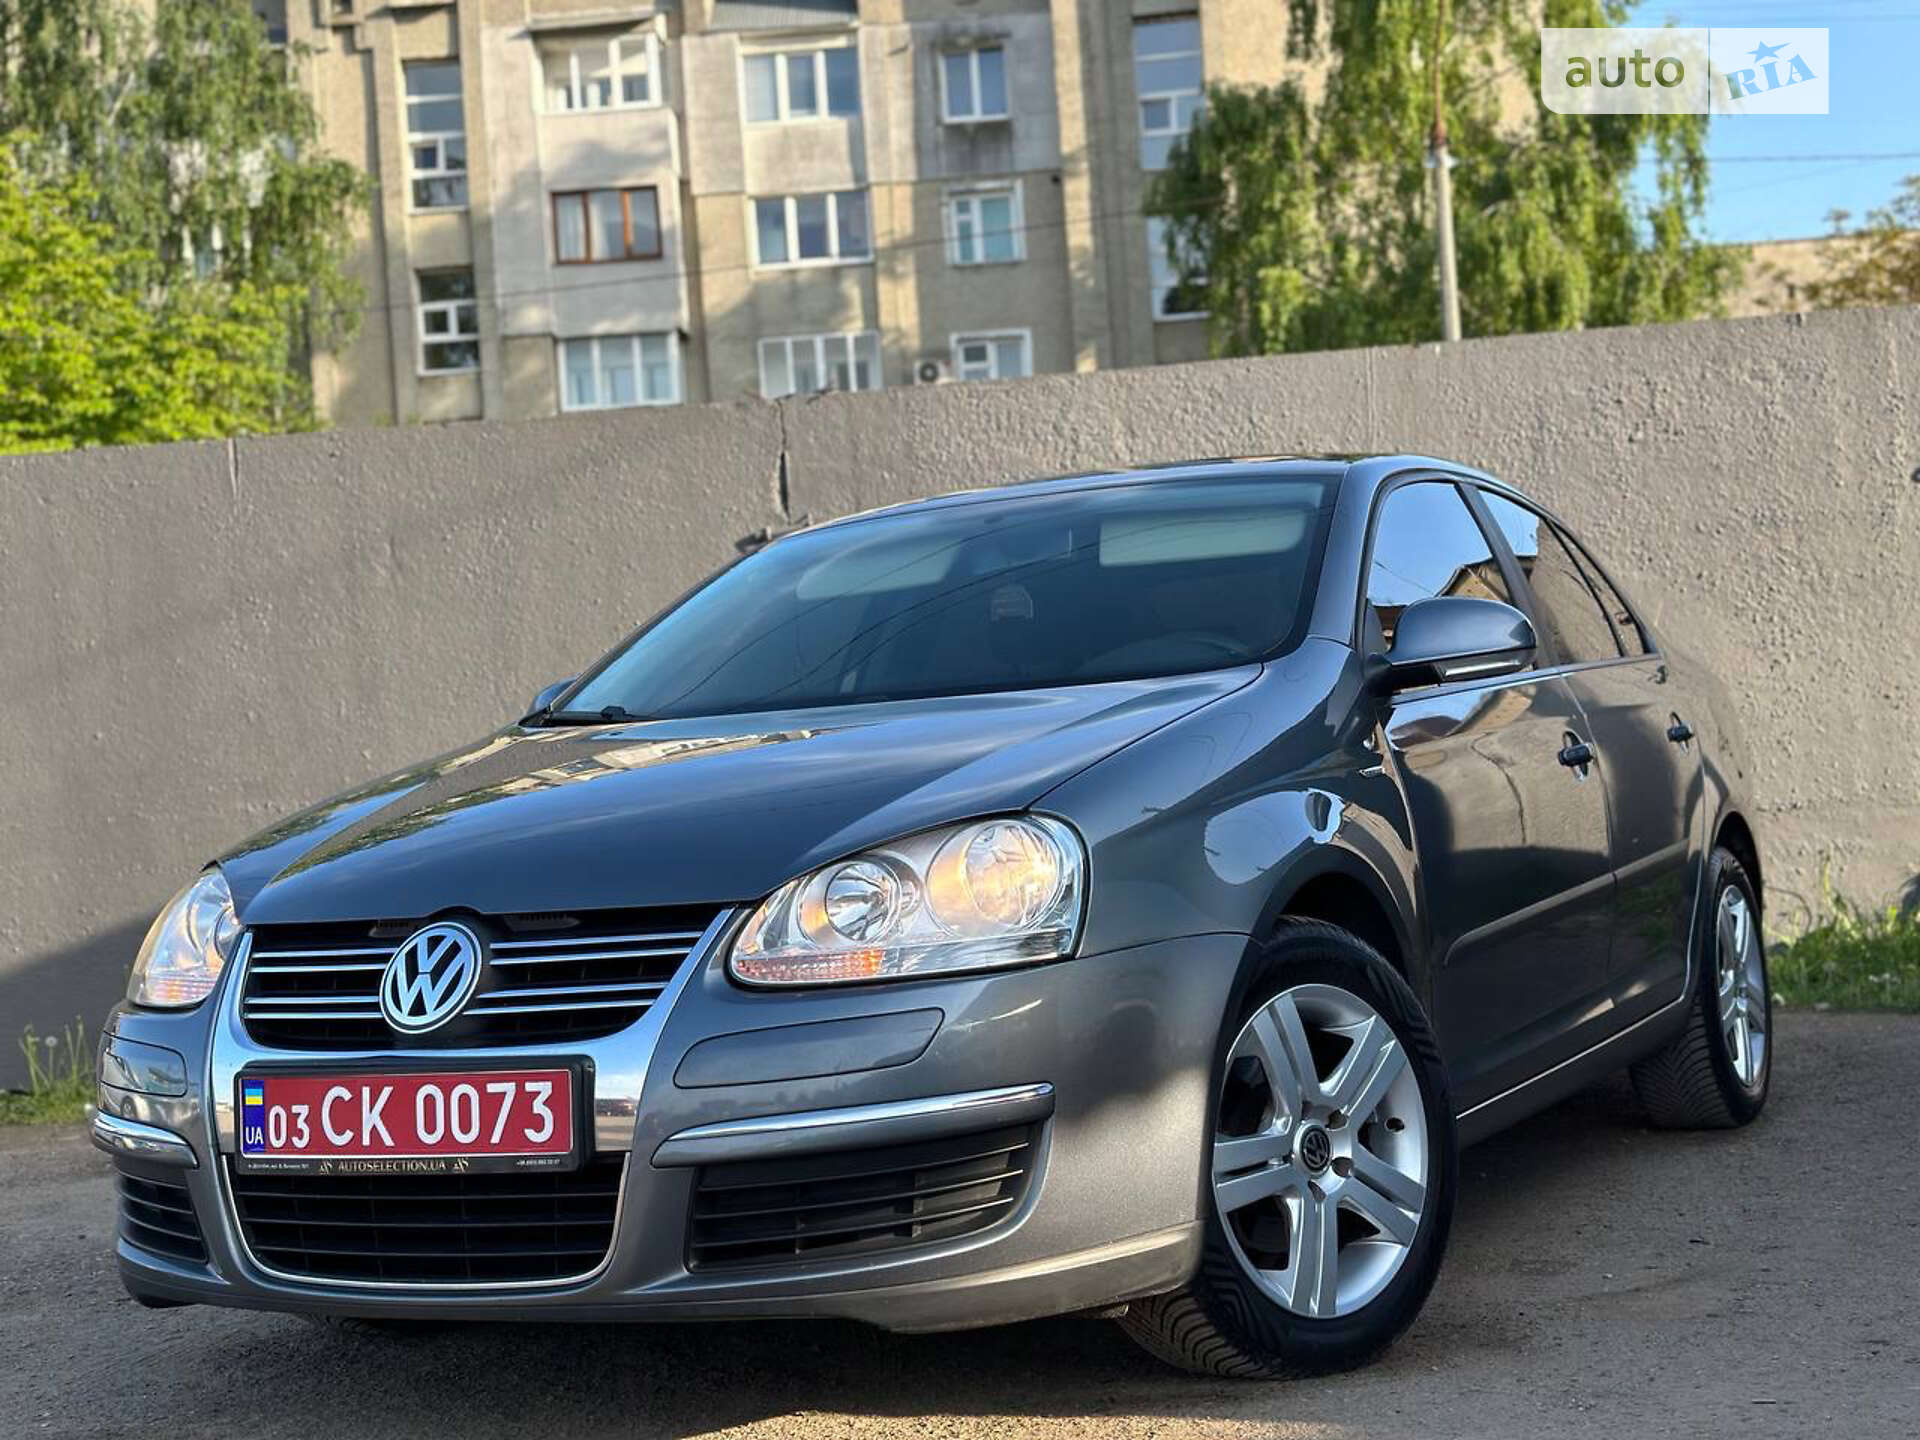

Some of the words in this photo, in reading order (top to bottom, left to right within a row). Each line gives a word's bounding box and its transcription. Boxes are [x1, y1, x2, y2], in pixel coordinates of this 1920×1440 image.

[268, 1104, 311, 1149] 03
[321, 1084, 395, 1147] CK
[416, 1079, 554, 1145] 0073
[245, 1127, 264, 1145] UA
[338, 1159, 446, 1172] AUTOSELECTION.UA
